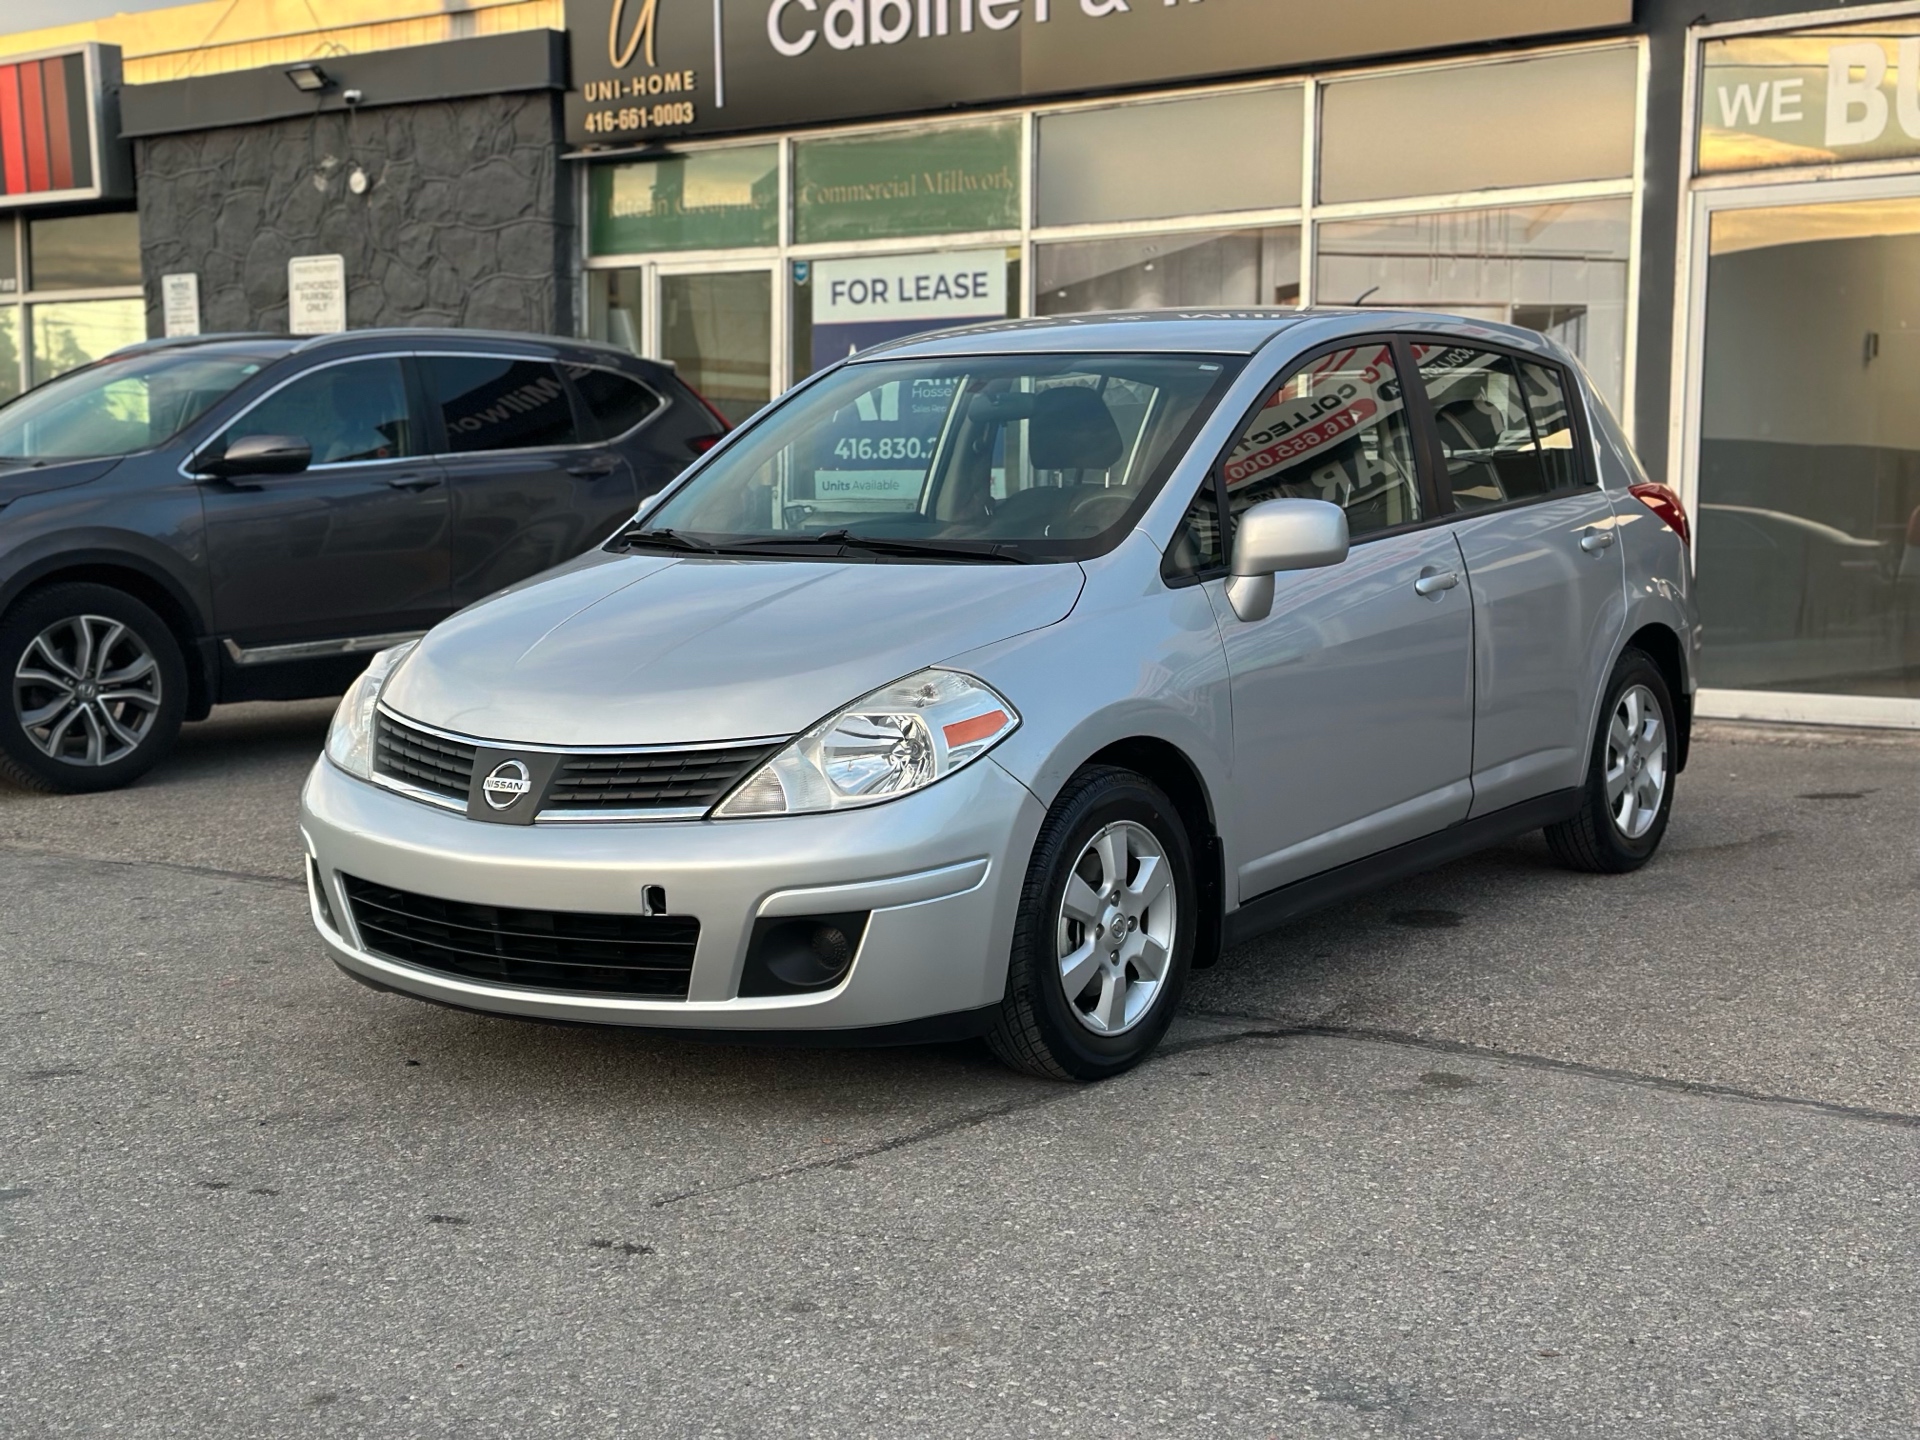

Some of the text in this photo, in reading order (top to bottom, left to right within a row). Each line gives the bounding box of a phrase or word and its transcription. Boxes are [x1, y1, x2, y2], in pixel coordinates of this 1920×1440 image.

[584, 70, 695, 102] UNI-HOME
[1717, 77, 1804, 127] WE
[584, 101, 695, 133] 416-661-0003
[799, 166, 1014, 204] Commercial Millwork
[830, 272, 988, 306] FOR LEASE
[911, 386, 955, 398] Hosse
[822, 479, 900, 491] Units Available
[485, 779, 524, 791] NISSAN
